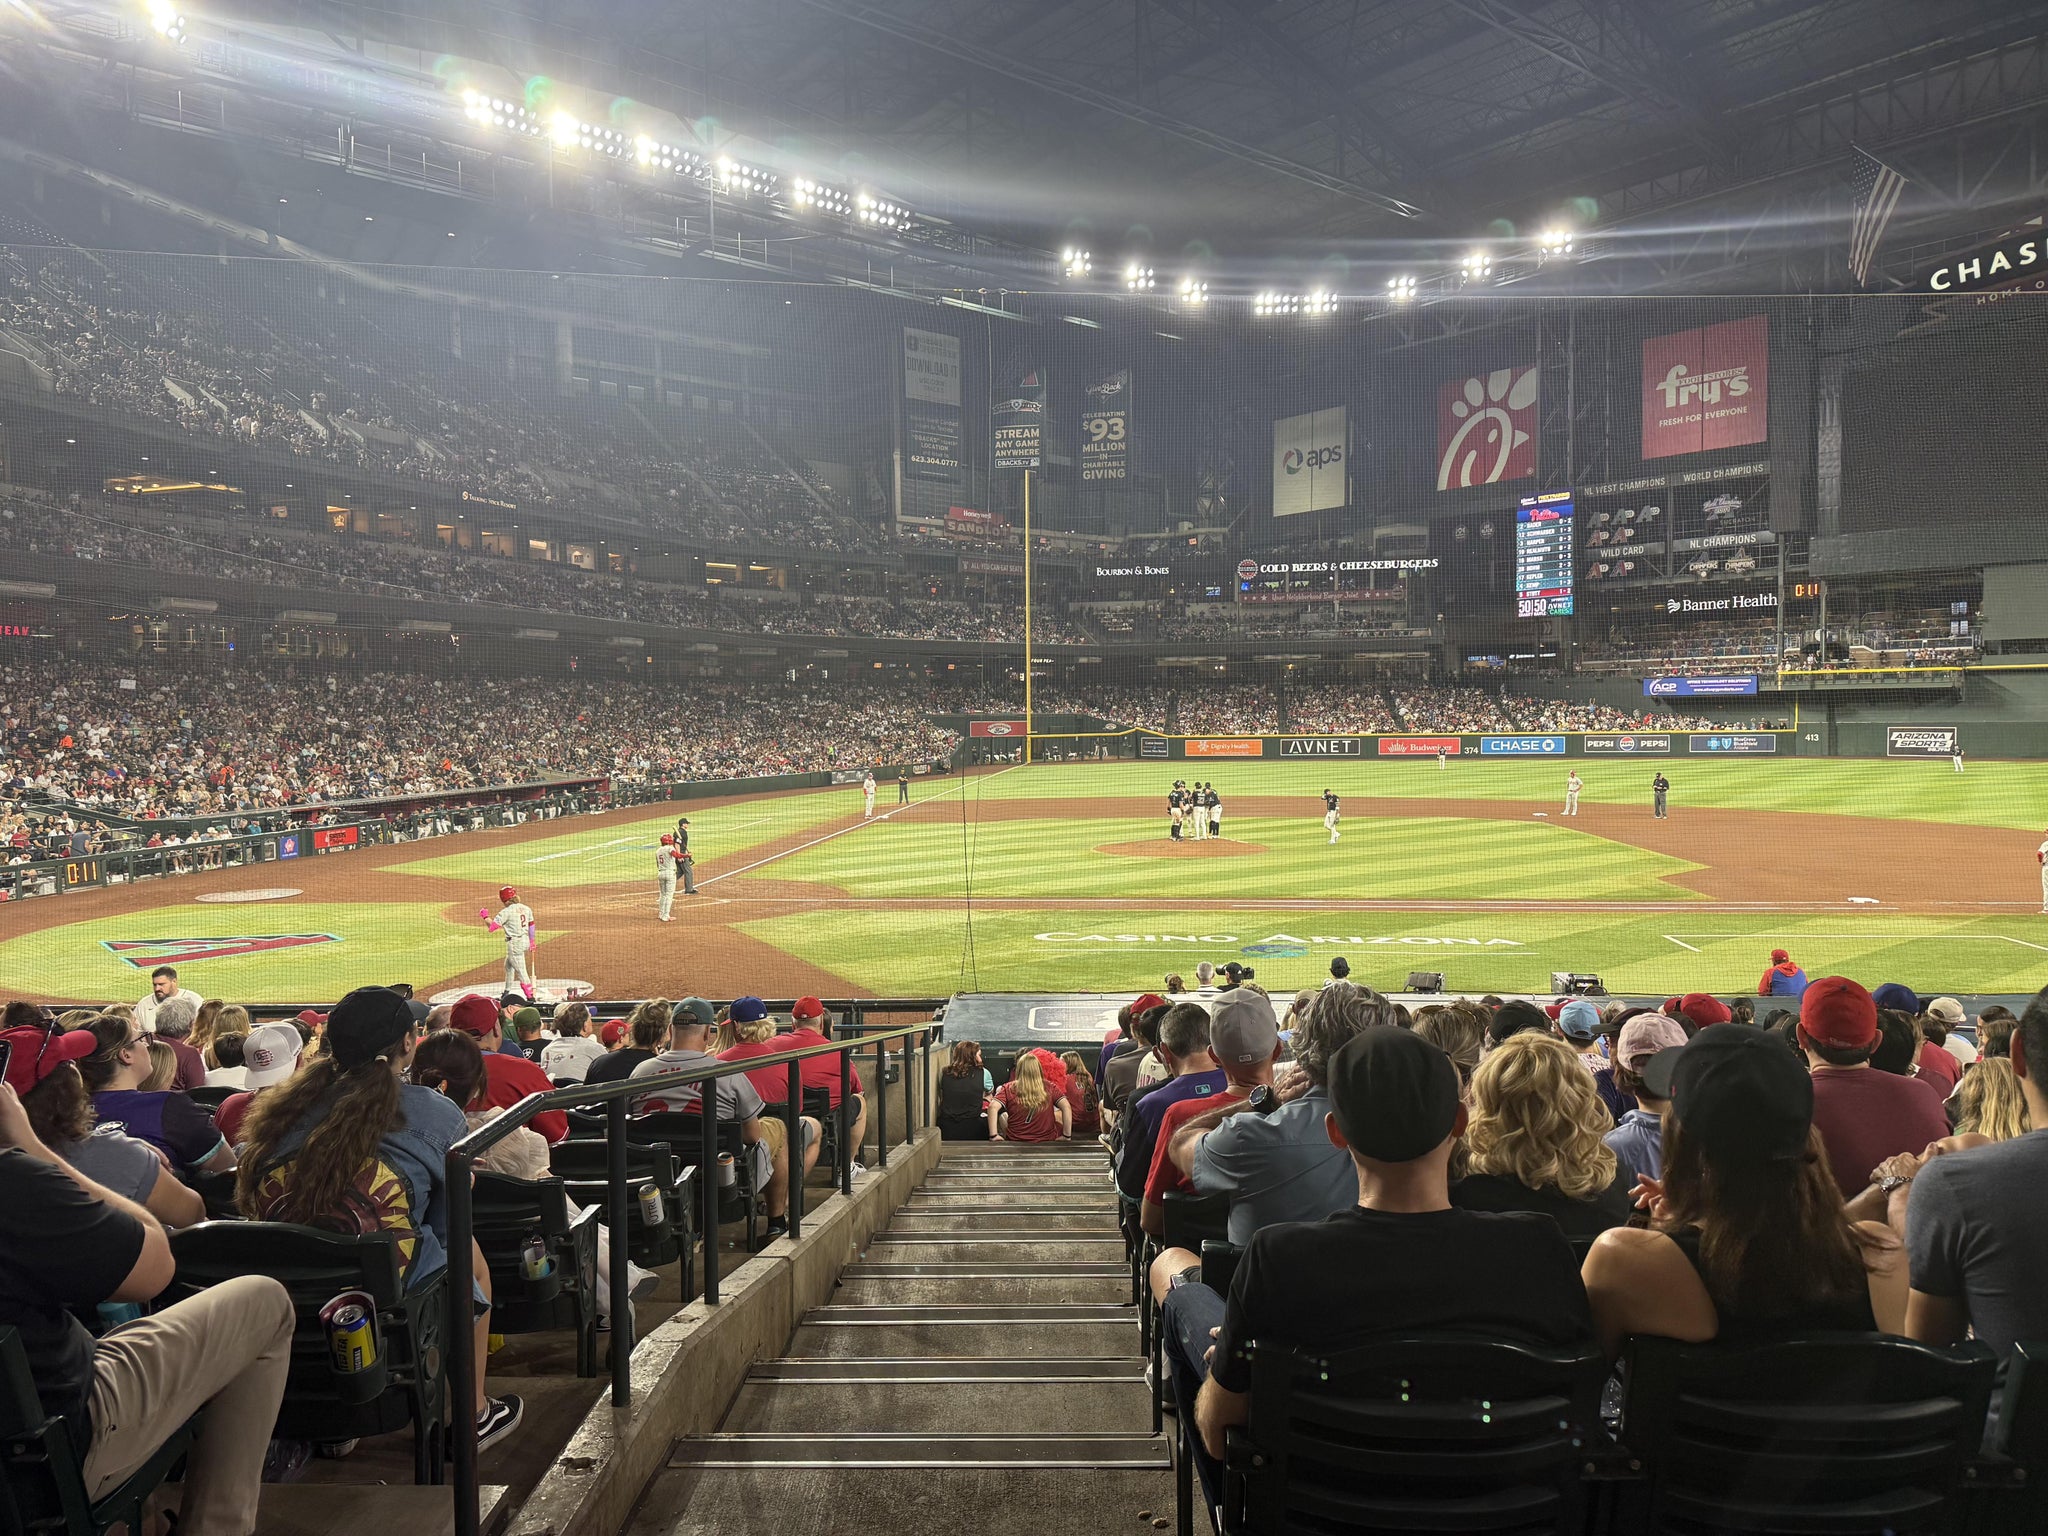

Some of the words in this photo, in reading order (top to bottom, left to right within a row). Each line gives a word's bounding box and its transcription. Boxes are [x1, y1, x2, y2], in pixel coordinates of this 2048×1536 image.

[1930, 238, 2048, 290] CHAS
[1977, 286, 2021, 305] HOME
[906, 356, 949, 377] DOWNLOAD
[1656, 365, 1749, 408] fry's
[1659, 417, 1683, 427] FRESH
[1686, 414, 1702, 422] FOR
[1706, 406, 1748, 419] EVERYONE
[995, 429, 1039, 439] STREAM
[1083, 418, 1125, 441] $93
[921, 442, 949, 450] LOCATION
[995, 441, 1013, 449] ANY
[1083, 442, 1125, 452] MILLION
[995, 449, 1039, 457] ANYWHERE
[1307, 445, 1342, 470] aps
[911, 455, 958, 467] 623.304.0777
[1083, 461, 1125, 469] CHARITABLE
[1083, 469, 1125, 479] GIVING
[1684, 471, 1711, 482] WORLD
[1714, 464, 1764, 479] CHAMPIONS
[1584, 487, 1593, 496] NL
[1596, 484, 1617, 494] WEST
[1619, 477, 1665, 491] CHAMPIONS
[963, 510, 992, 519] Honeywell
[1690, 540, 1701, 549] NL
[1703, 534, 1757, 547] CHAMPIONS
[1600, 548, 1621, 557] WILD
[1623, 546, 1644, 556] CARD
[1134, 566, 1143, 575] &
[1260, 564, 1289, 573] COLD
[1292, 562, 1328, 572] BEERS
[1331, 563, 1338, 571] &
[1340, 559, 1439, 570] CHEESEBURGERS
[1795, 584, 1818, 597] 0:11
[1683, 599, 1730, 611] Banner
[1733, 593, 1778, 608] Health
[1654, 683, 1677, 691] ACP
[1587, 740, 1614, 748] PEPSI
[1640, 740, 1668, 748] PEPSI
[1805, 734, 1819, 742] 413
[1290, 740, 1351, 753] AVNET
[1491, 740, 1539, 750] CHASE
[659, 855, 664, 864] 5
[67, 861, 97, 884] 0:11
[520, 915, 526, 927] 2
[1034, 932, 1238, 943] CASINO
[1259, 934, 1524, 946] ARIZONA
